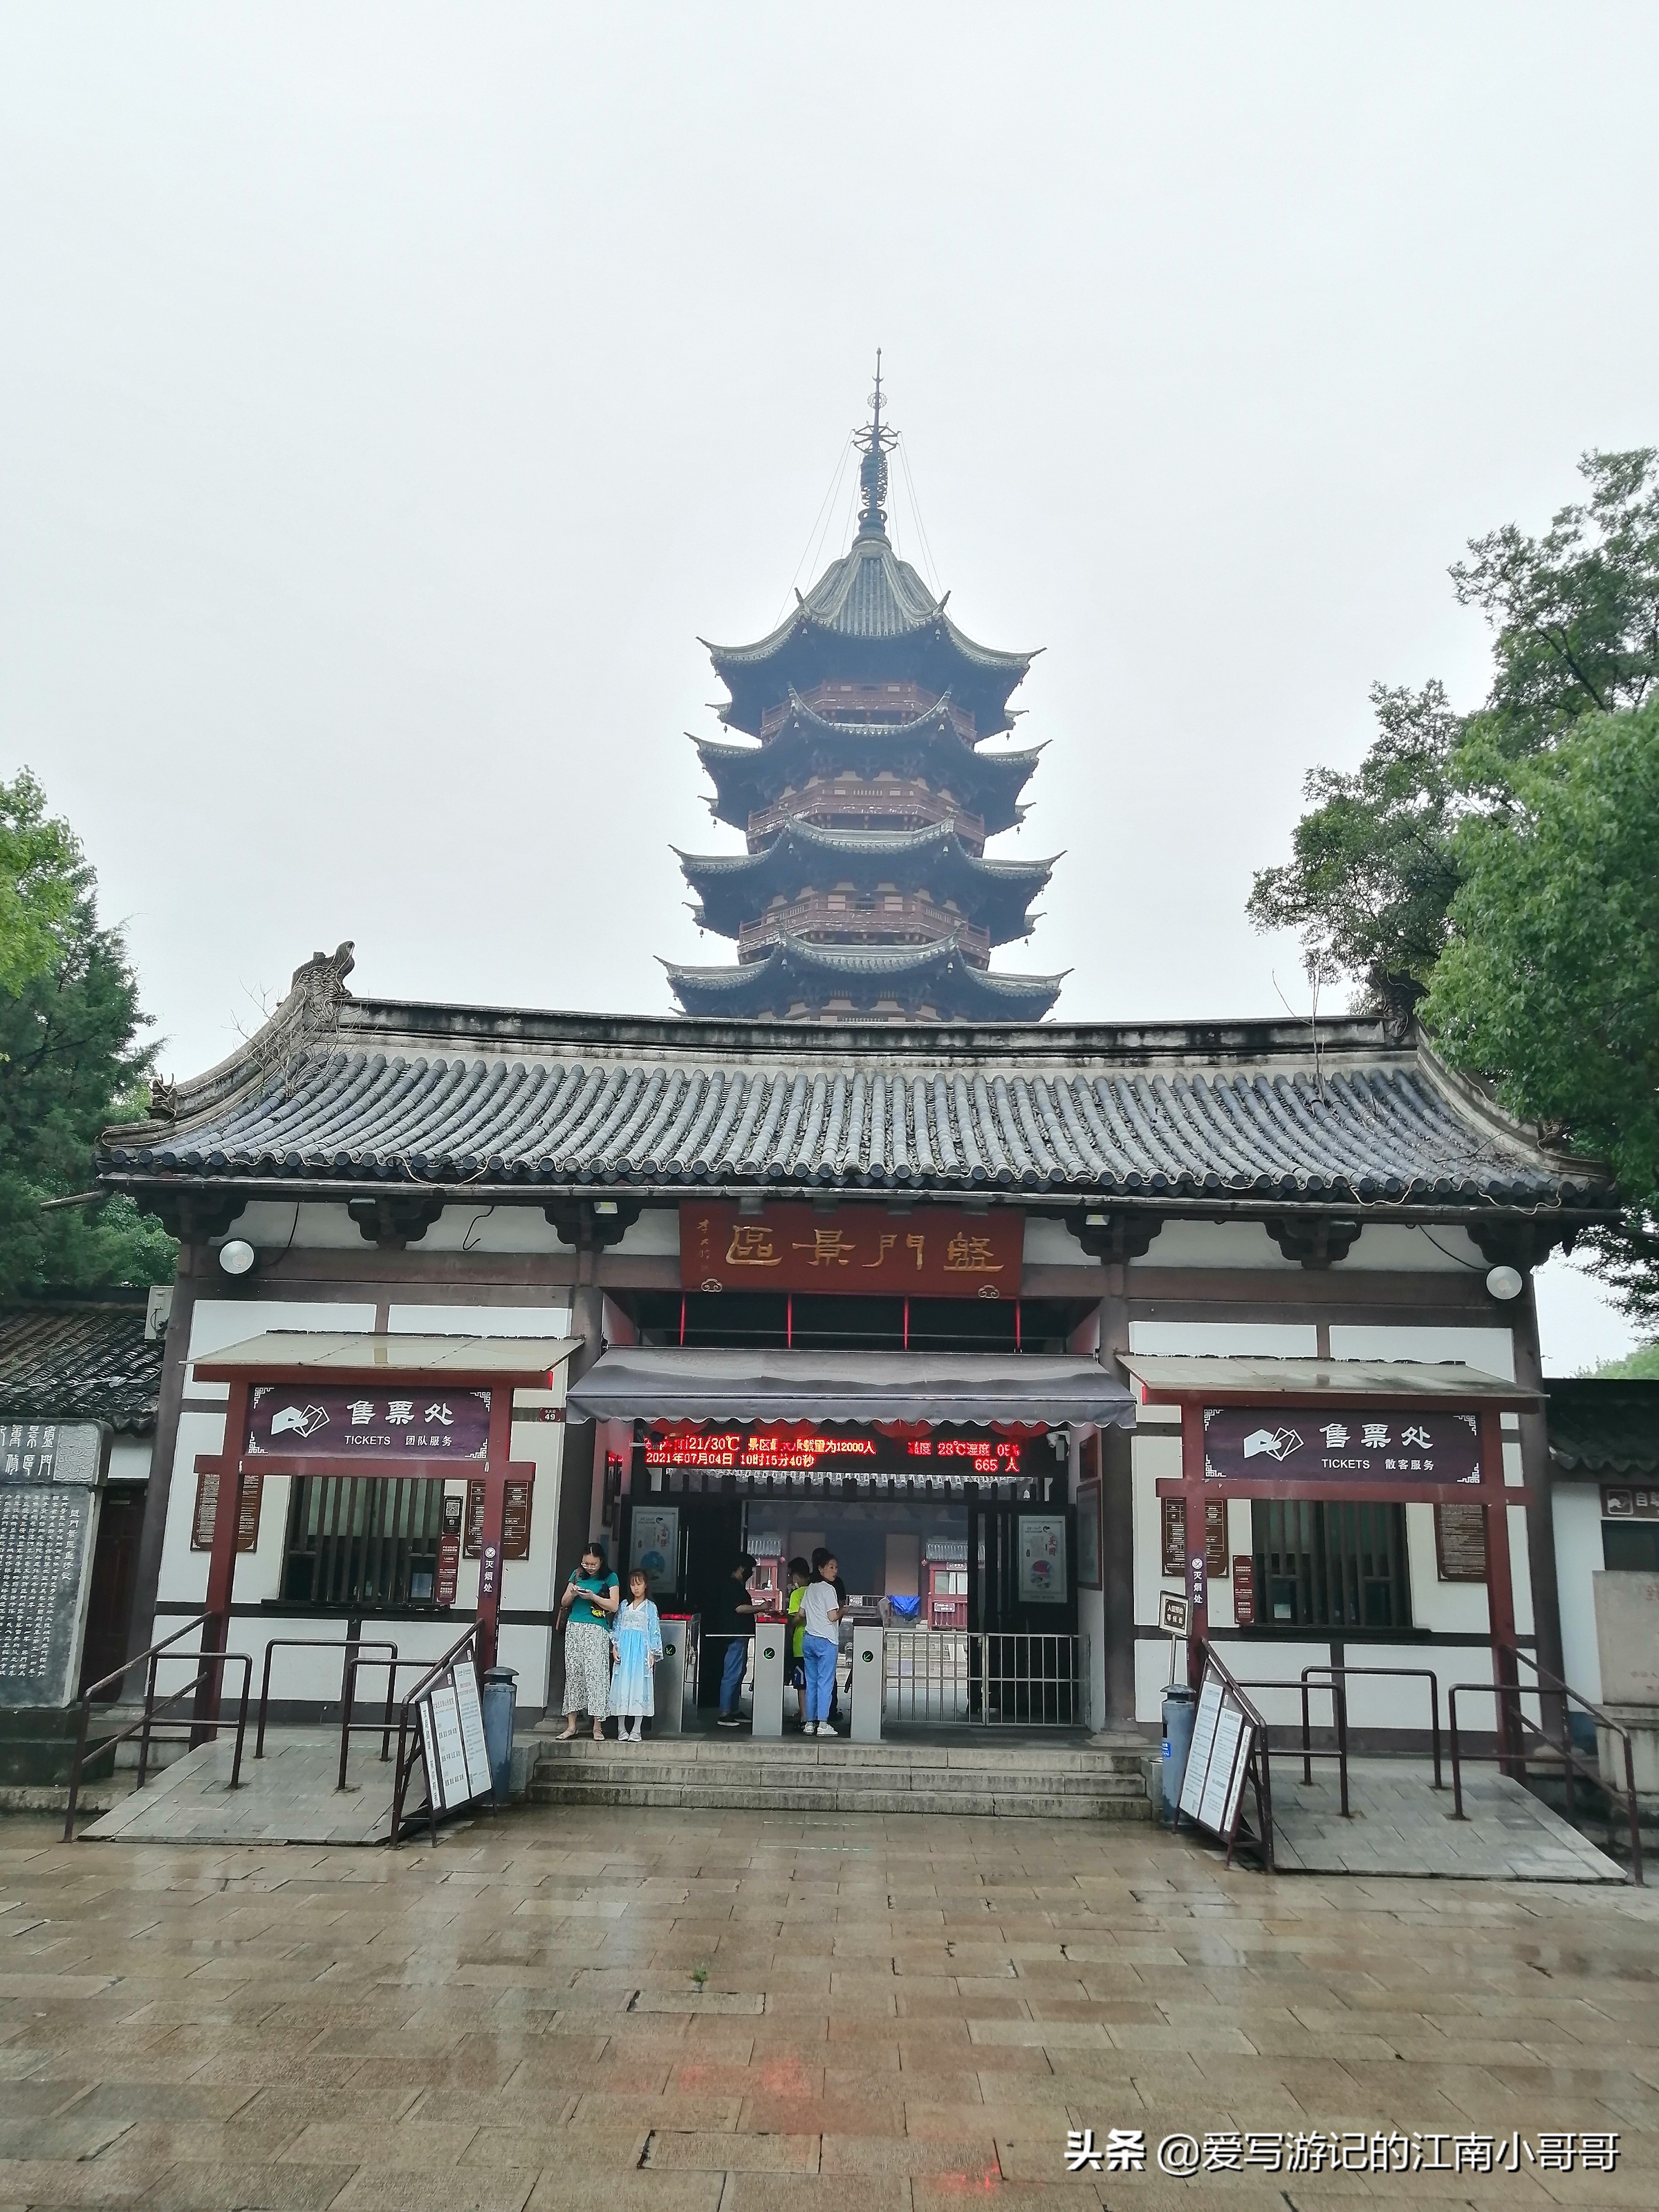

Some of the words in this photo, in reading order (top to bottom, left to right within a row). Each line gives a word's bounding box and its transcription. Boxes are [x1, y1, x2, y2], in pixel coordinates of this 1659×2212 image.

[347, 1400, 454, 1425] 售票处
[344, 1435, 391, 1446] TICKETS
[405, 1435, 453, 1447] 团队服务
[1319, 1423, 1434, 1449] 售票处
[647, 1452, 733, 1465] 2021年07月04日
[741, 1452, 814, 1467] 10时15分40秒
[975, 1459, 998, 1472] 665
[1005, 1456, 1020, 1472] 人
[1321, 1458, 1370, 1469] TICKETS
[1385, 1458, 1434, 1471] 散客服务
[483, 1560, 494, 1592] 灭烟处
[1193, 1571, 1203, 1603] 灭烟处
